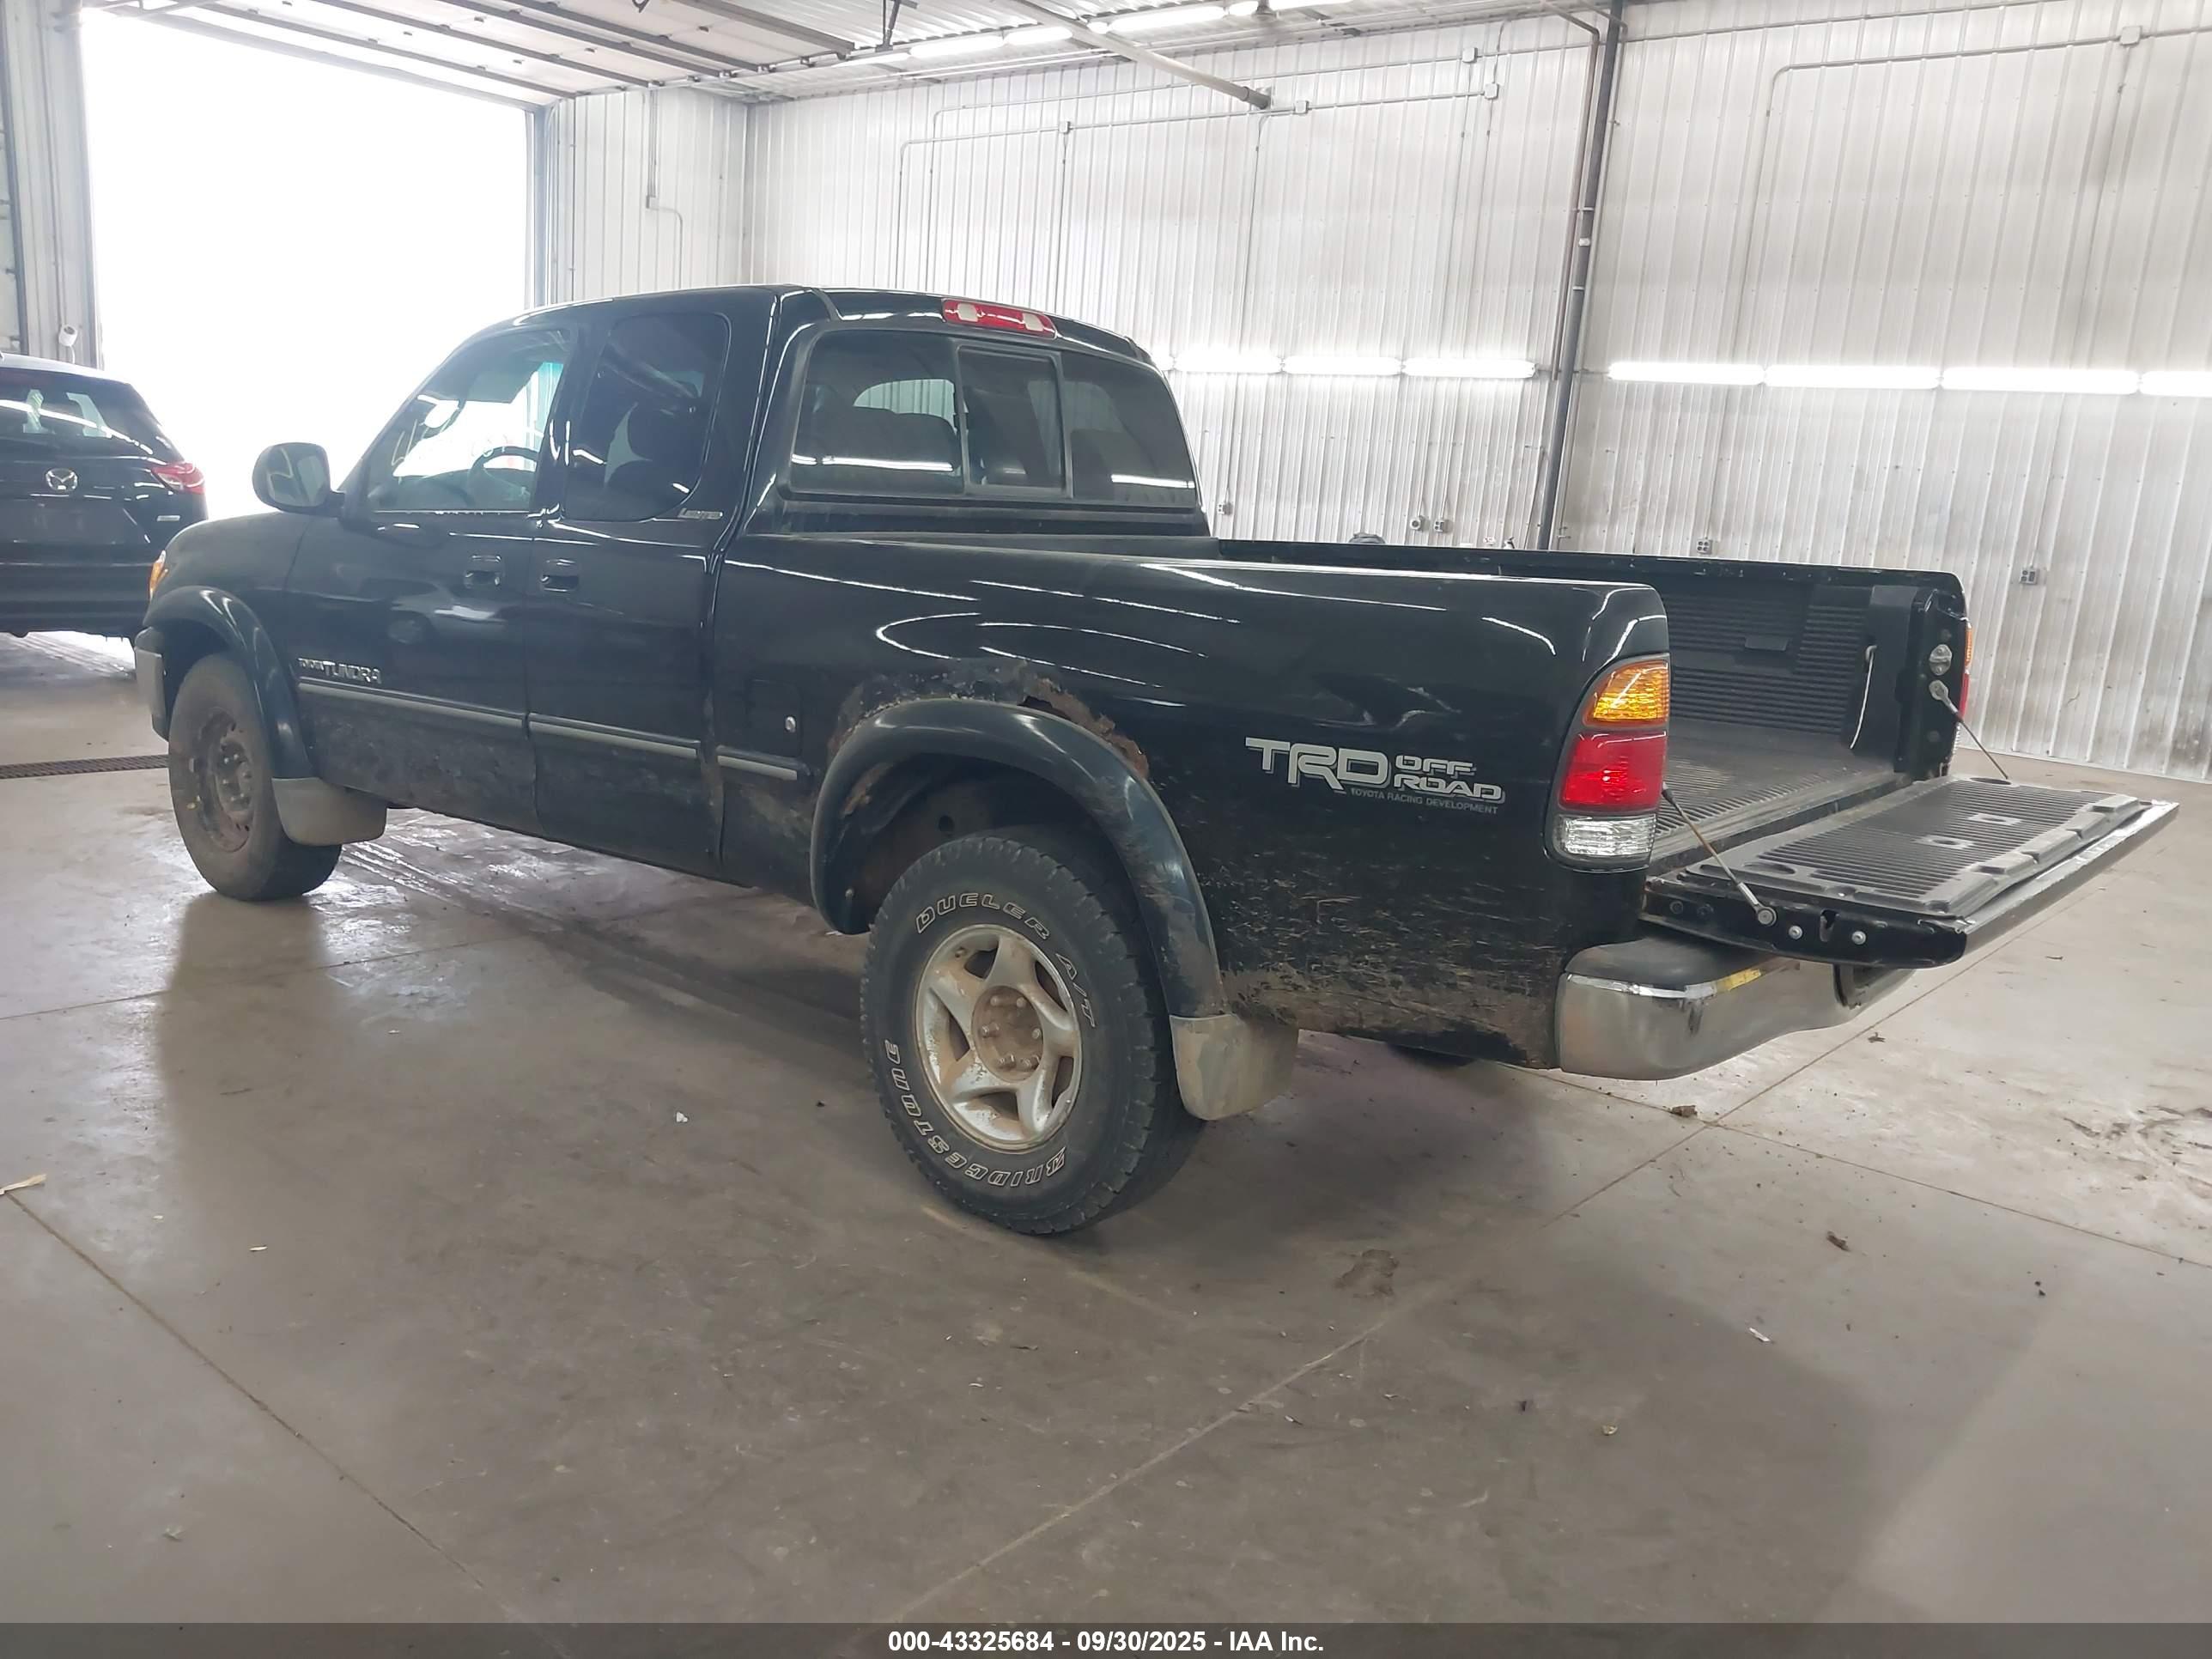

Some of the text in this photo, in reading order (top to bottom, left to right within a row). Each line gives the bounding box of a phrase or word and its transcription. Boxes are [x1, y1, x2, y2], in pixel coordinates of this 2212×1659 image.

[1245, 737, 1392, 794] TRD
[1395, 755, 1477, 776] OFF
[1350, 787, 1498, 815] TOYOTA RACING DEVELOPMENT
[1394, 775, 1505, 804] ROAD
[915, 891, 1097, 1029] DUELER A/T
[884, 1038, 1066, 1188] BRIDGESTONE
